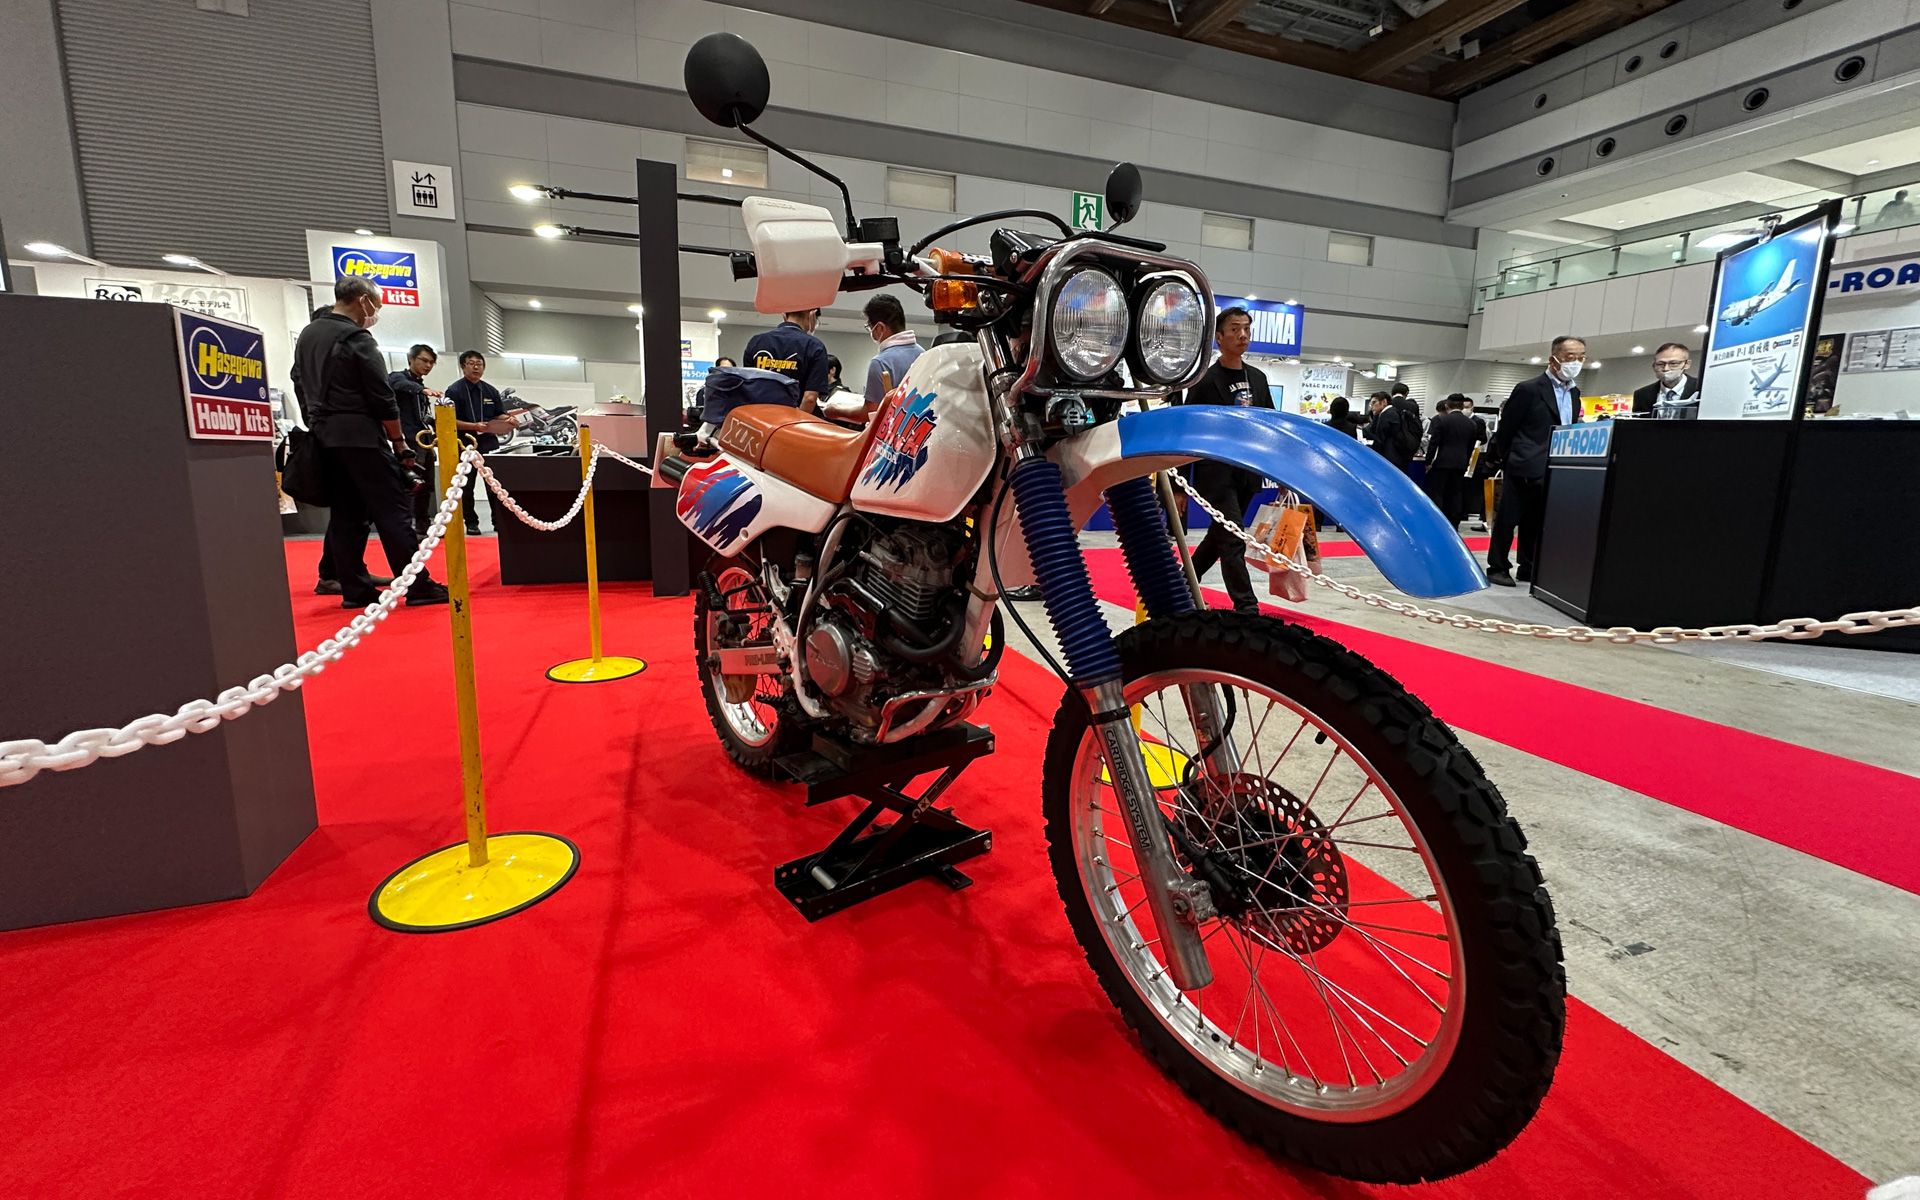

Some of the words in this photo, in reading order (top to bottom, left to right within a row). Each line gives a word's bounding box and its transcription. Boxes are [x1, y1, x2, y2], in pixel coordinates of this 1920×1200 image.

[345, 258, 413, 280] Hasegawa
[387, 290, 416, 305] kits
[199, 342, 262, 384] Hasegawa
[756, 356, 798, 372] Hasegawa
[196, 402, 241, 434] Hobby
[243, 407, 270, 432] kits
[875, 402, 937, 460] BAJA
[874, 443, 898, 465] HONDA
[1550, 428, 1608, 456] PIT-ROAD
[1105, 729, 1133, 798] CARTRIDGE
[1129, 797, 1150, 848] SYSTEM
